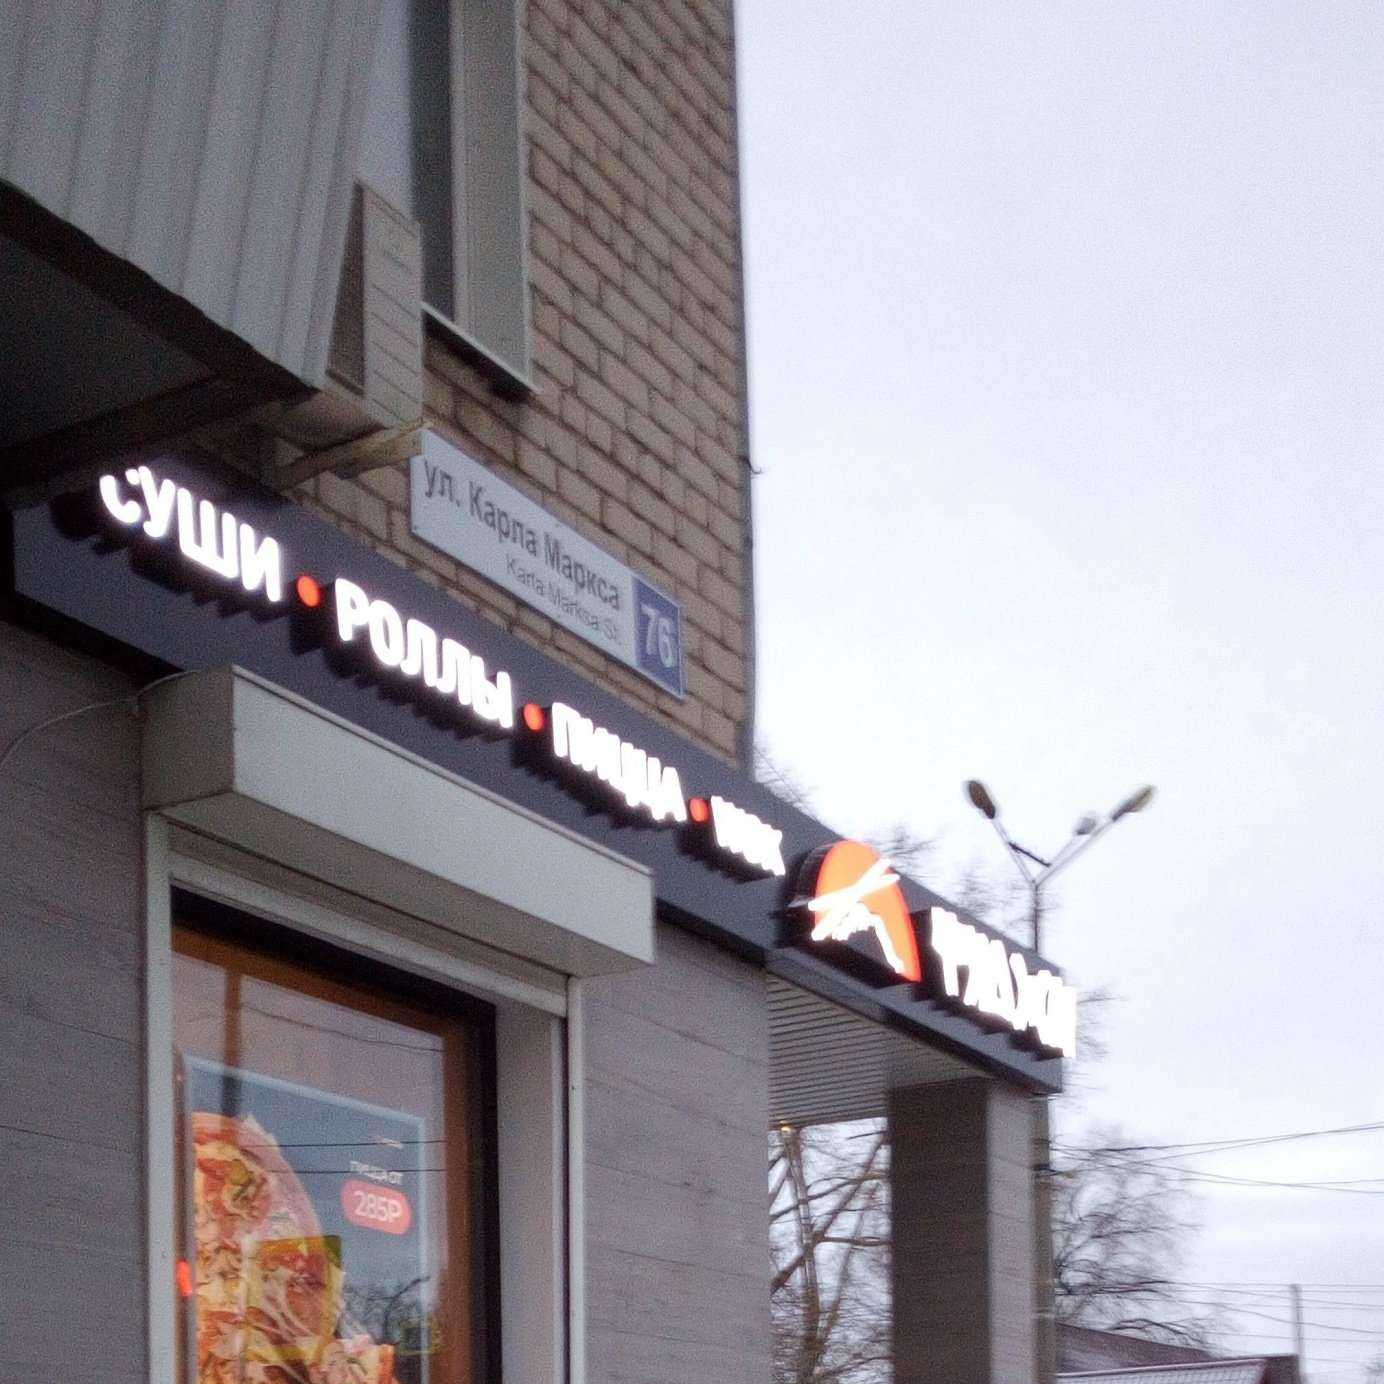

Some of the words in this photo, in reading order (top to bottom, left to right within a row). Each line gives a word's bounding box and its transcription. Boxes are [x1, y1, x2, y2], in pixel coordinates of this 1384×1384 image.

[423, 459, 461, 508] ул.
[468, 479, 537, 557] Карла
[543, 530, 620, 612] Маркса
[506, 552, 545, 596] Karla
[547, 580, 600, 632] Marksa
[99, 465, 282, 602] СУШИ
[335, 577, 515, 729] РОЛЛЫ
[551, 702, 688, 822] ПИЦЦА
[639, 604, 674, 667] 76
